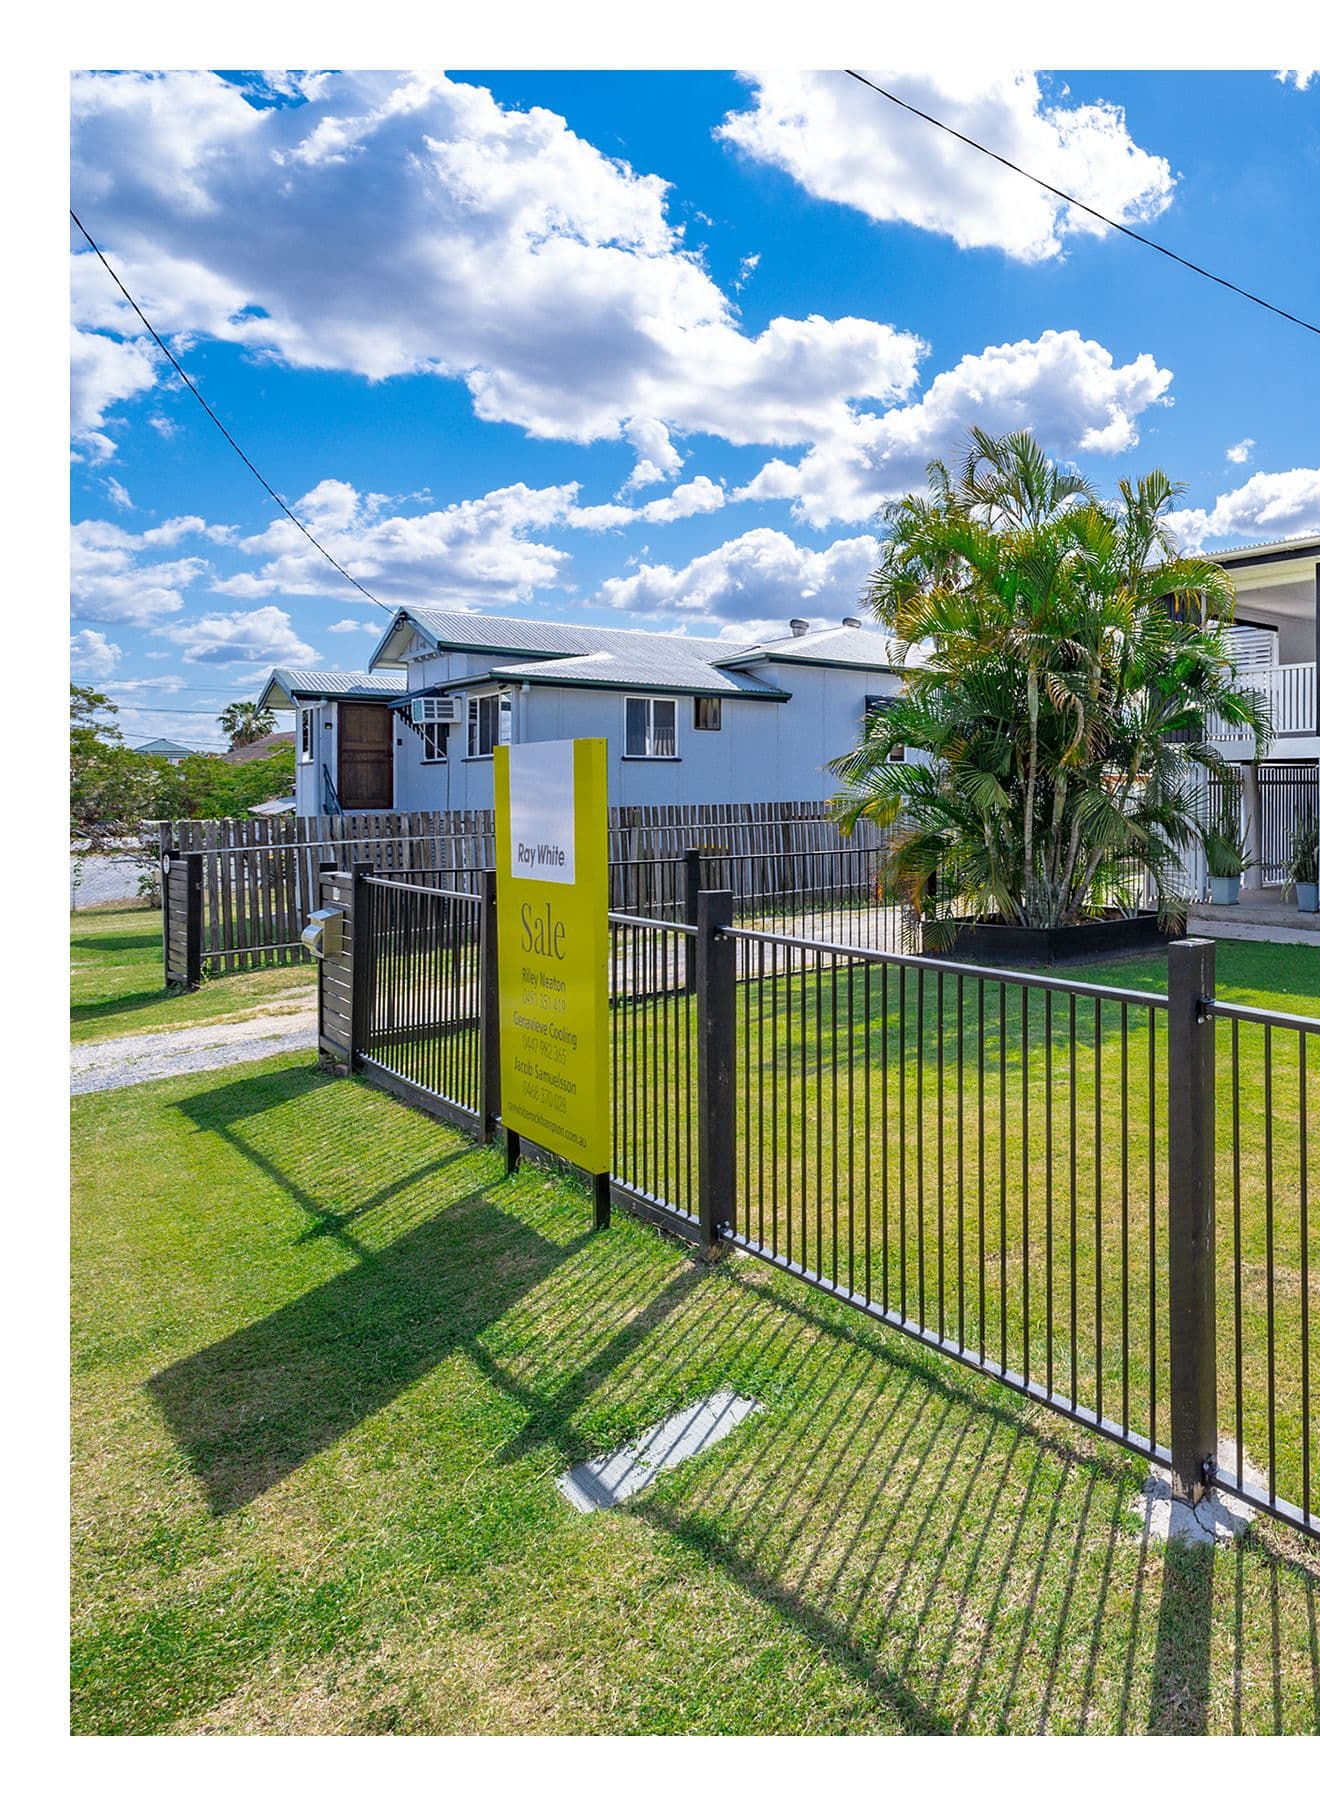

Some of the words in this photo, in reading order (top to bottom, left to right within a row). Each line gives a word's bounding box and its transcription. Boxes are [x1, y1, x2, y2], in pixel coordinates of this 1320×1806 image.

[517, 843, 535, 868] Ray
[537, 844, 565, 867] White
[521, 902, 567, 960] Sale
[522, 967, 538, 989] Riley
[540, 971, 566, 993] Neaton
[549, 1022, 577, 1050] Cooling
[514, 1056, 533, 1077] Jacob
[535, 1064, 577, 1095] Samuelsson
